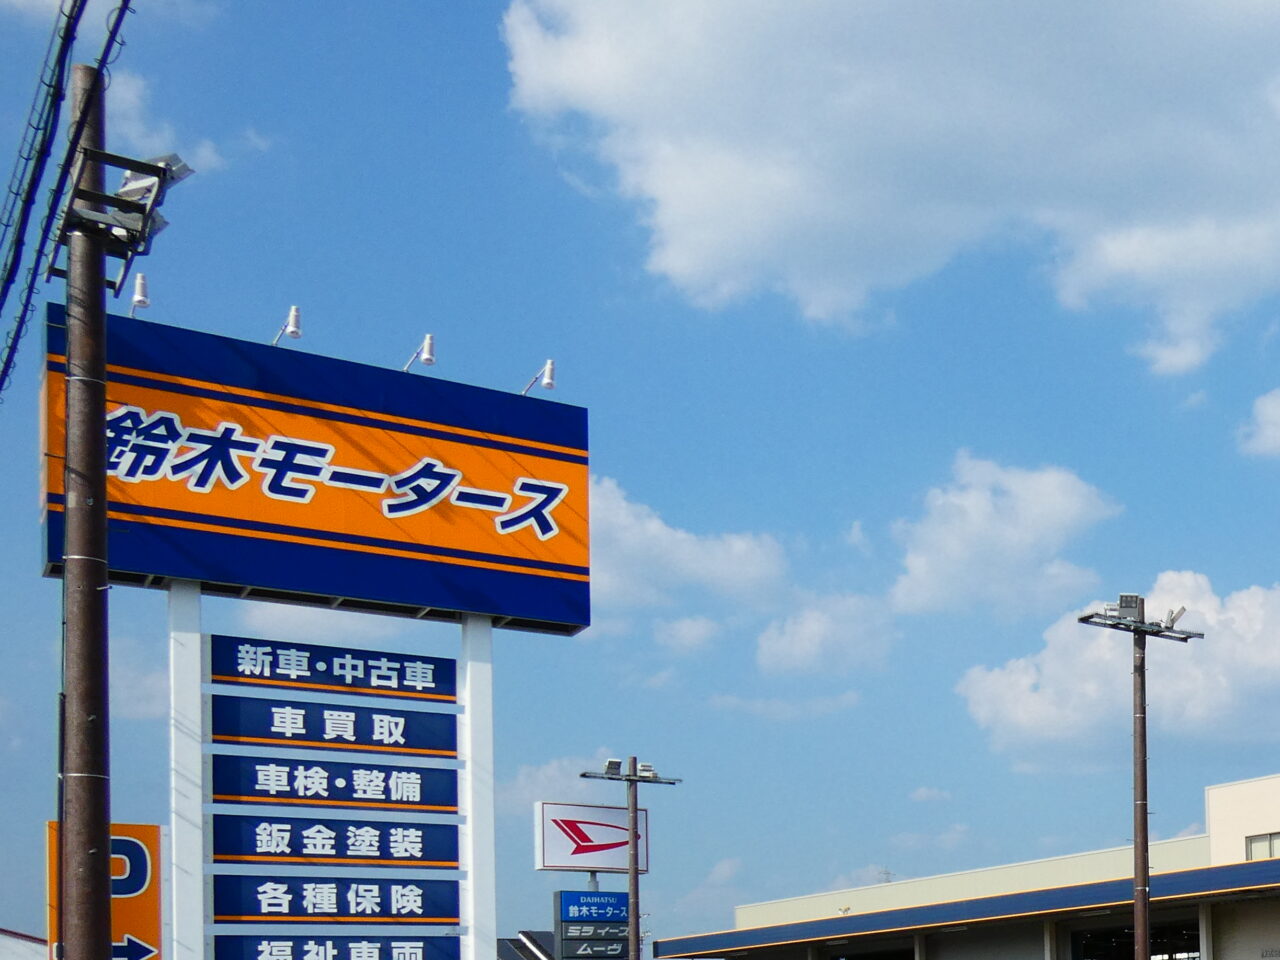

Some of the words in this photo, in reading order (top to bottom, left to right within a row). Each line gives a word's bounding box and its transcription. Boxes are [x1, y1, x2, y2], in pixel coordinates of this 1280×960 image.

[107, 405, 569, 540] 鈴木モータース
[237, 643, 436, 691] 新車・中古車
[270, 706, 406, 745] 車買取
[254, 763, 422, 802] 車検・整備
[255, 822, 423, 859] 鈑金塗装
[257, 881, 424, 915] 各種保険
[568, 904, 628, 918] 鈴木モータース
[580, 896, 618, 904] DAIHATSU
[576, 943, 623, 955] ムーヴ
